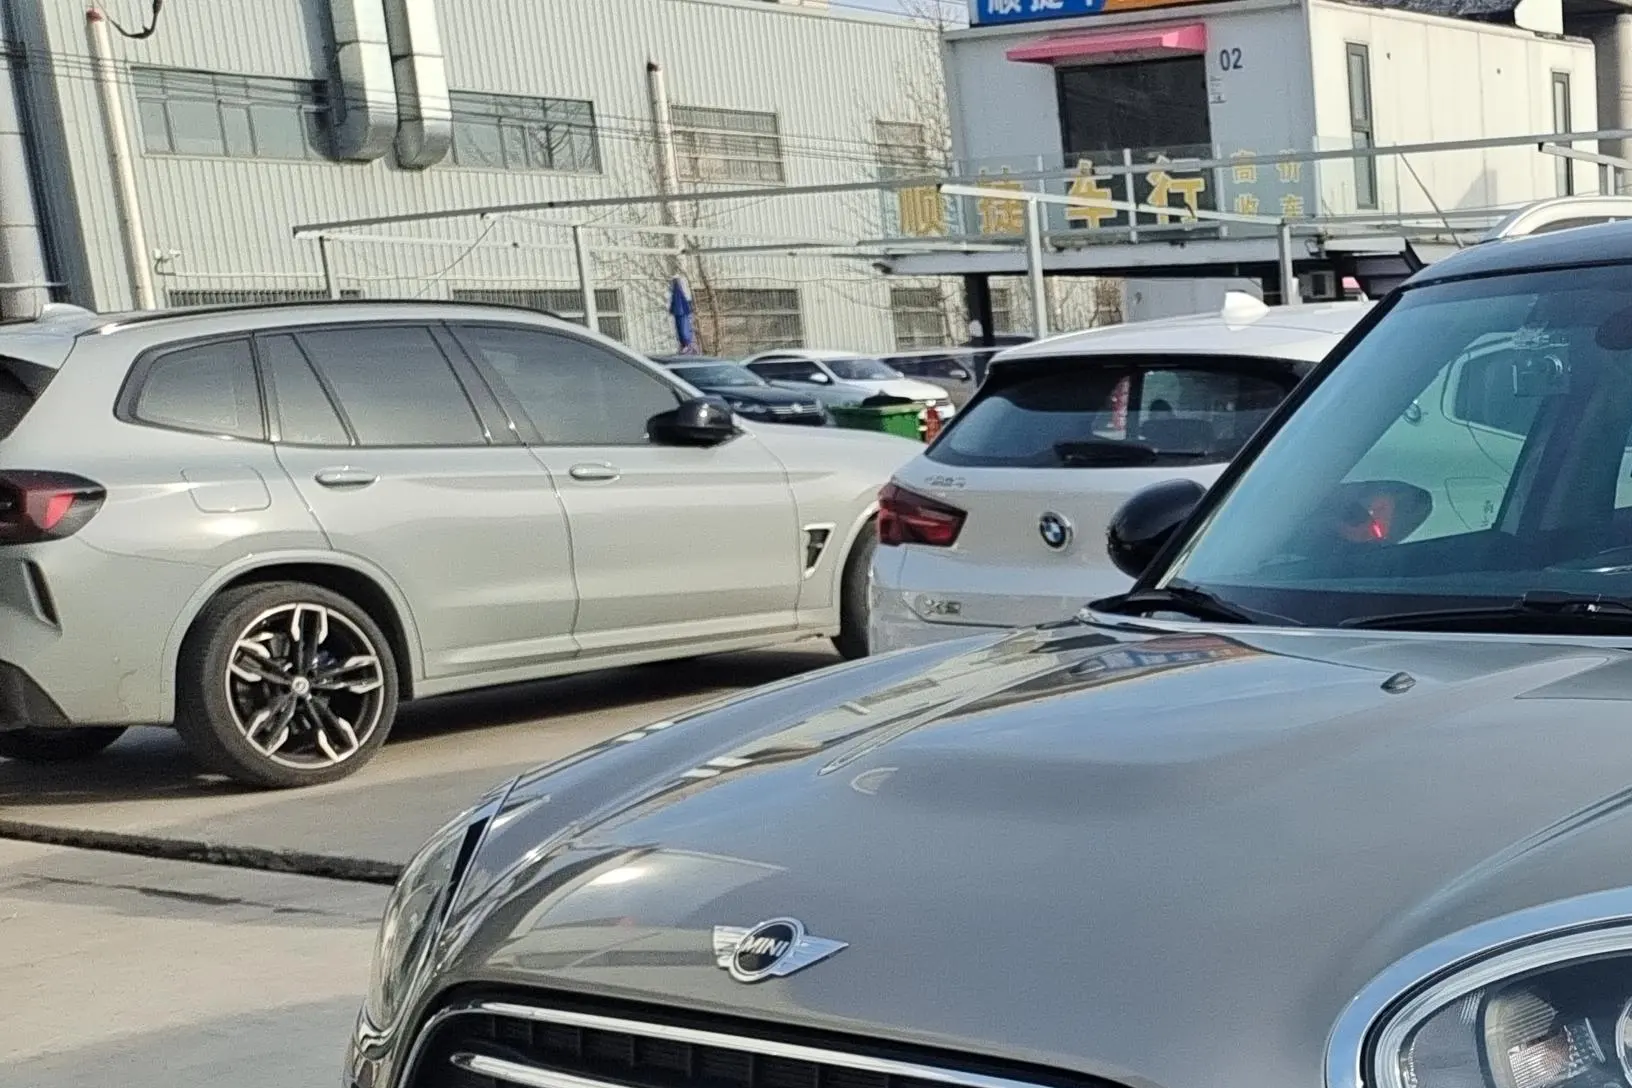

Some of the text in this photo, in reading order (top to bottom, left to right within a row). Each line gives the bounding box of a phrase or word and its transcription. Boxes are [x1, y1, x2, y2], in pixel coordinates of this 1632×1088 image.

[1220, 48, 1243, 71] 02
[899, 154, 1207, 238] 顺捷车行
[742, 936, 790, 957] MINI
